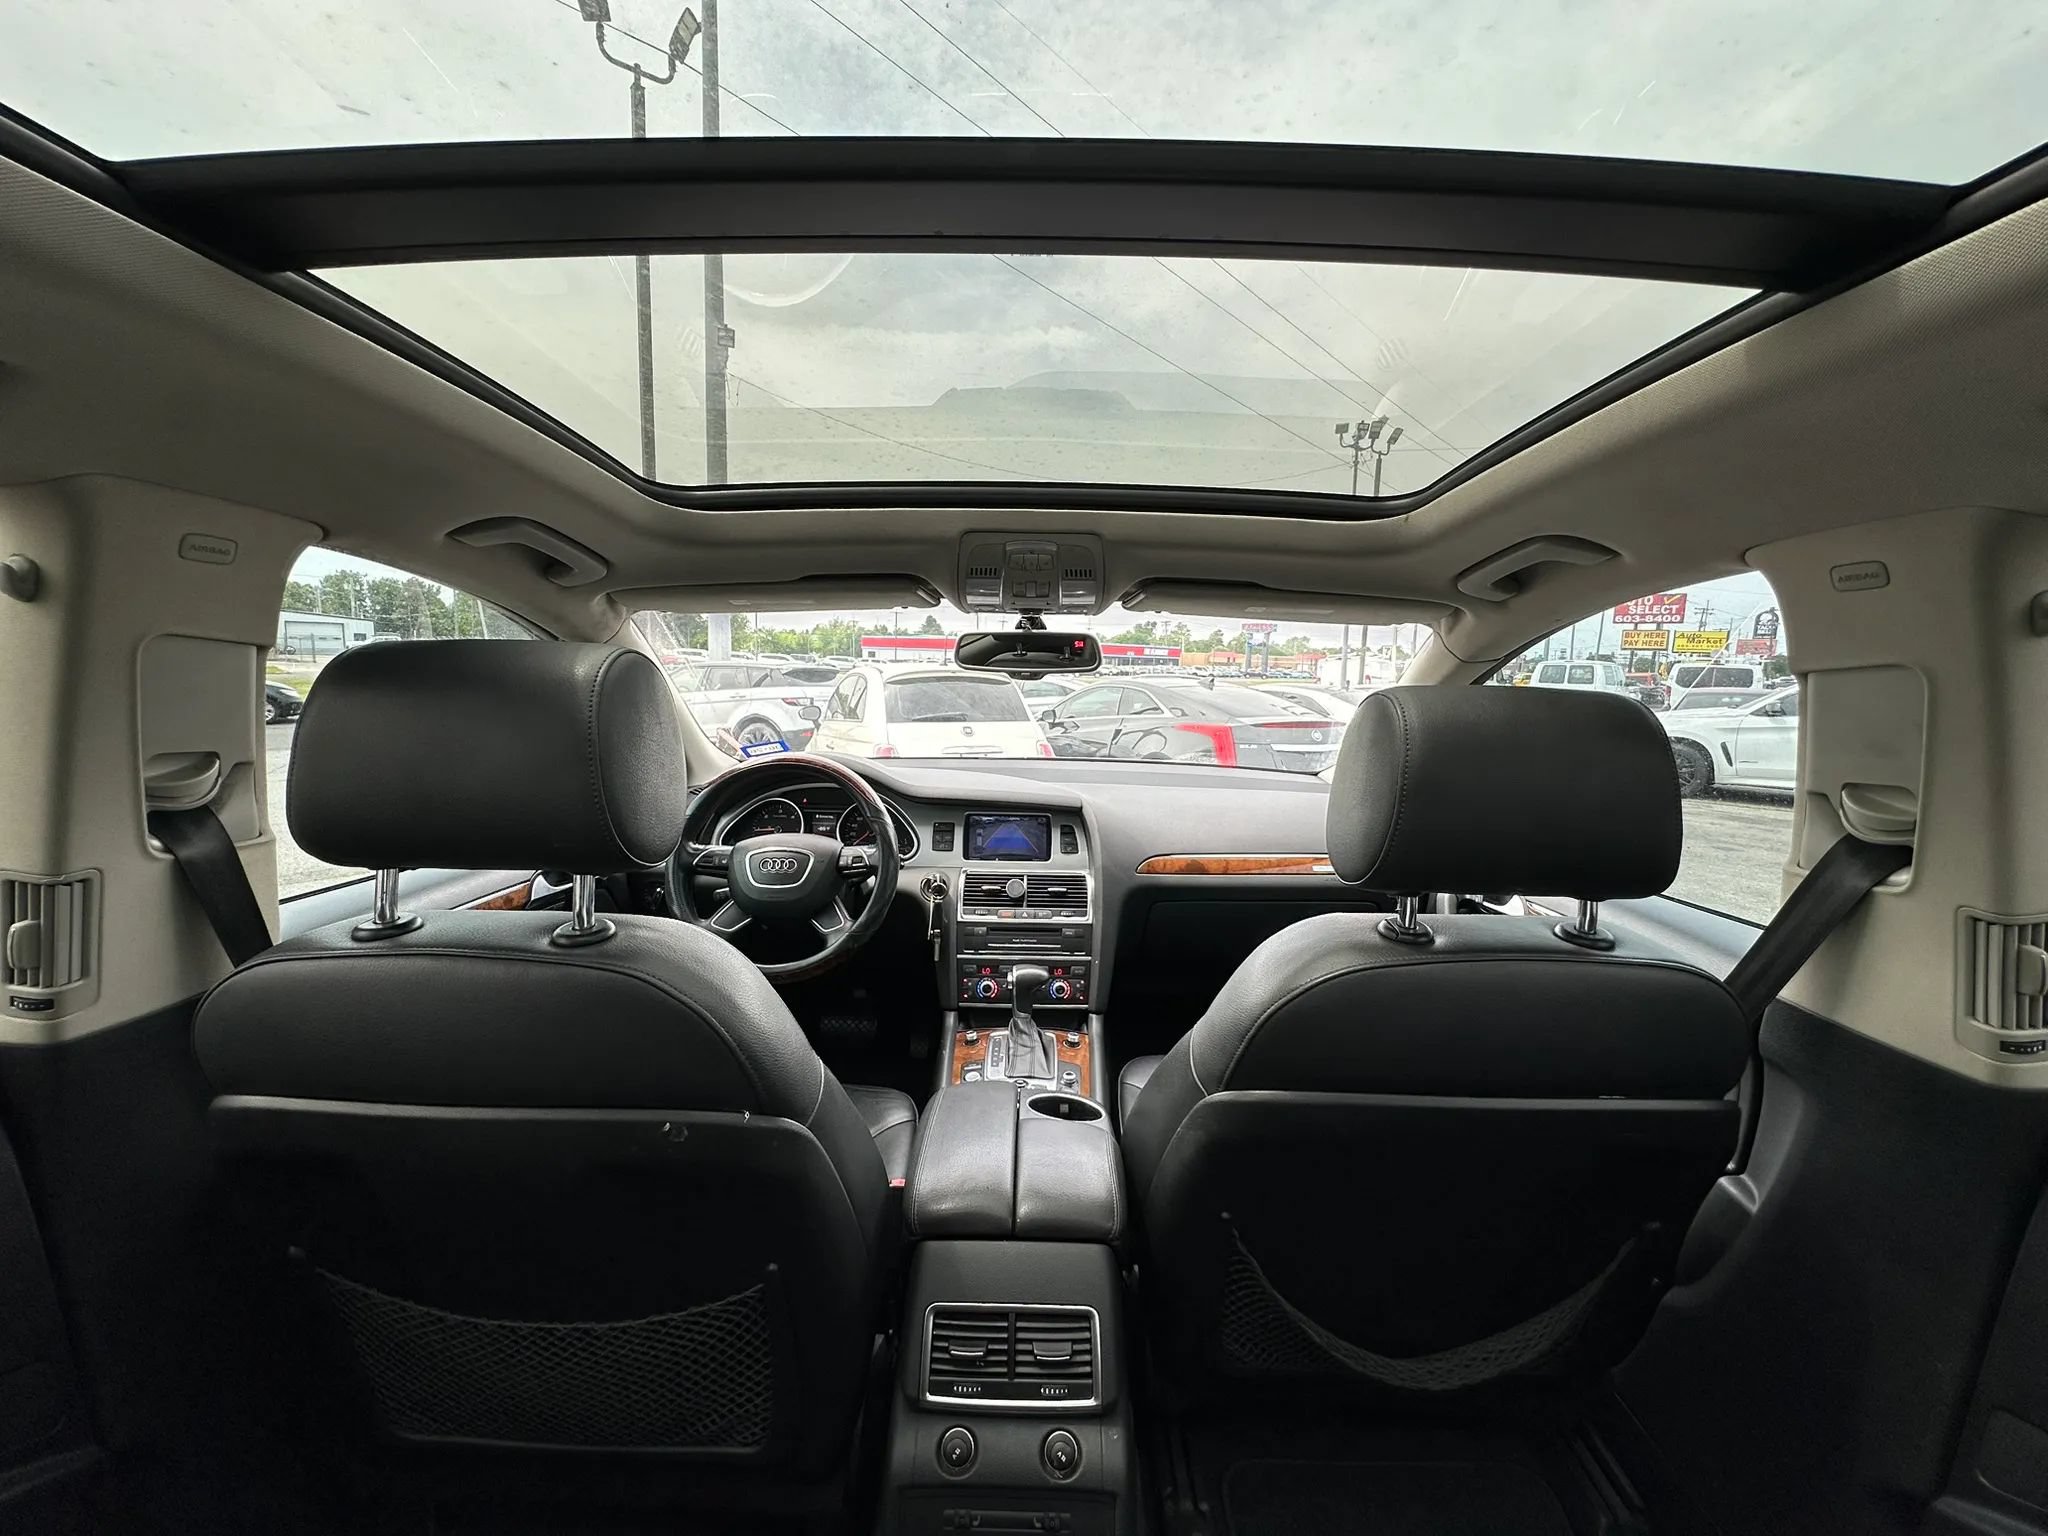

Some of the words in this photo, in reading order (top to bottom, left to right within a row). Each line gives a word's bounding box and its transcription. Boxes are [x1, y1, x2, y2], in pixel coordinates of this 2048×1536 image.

[187, 543, 232, 556] AIRBAG
[1837, 572, 1881, 583] AIRBAG
[1628, 605, 1679, 614] SELECT
